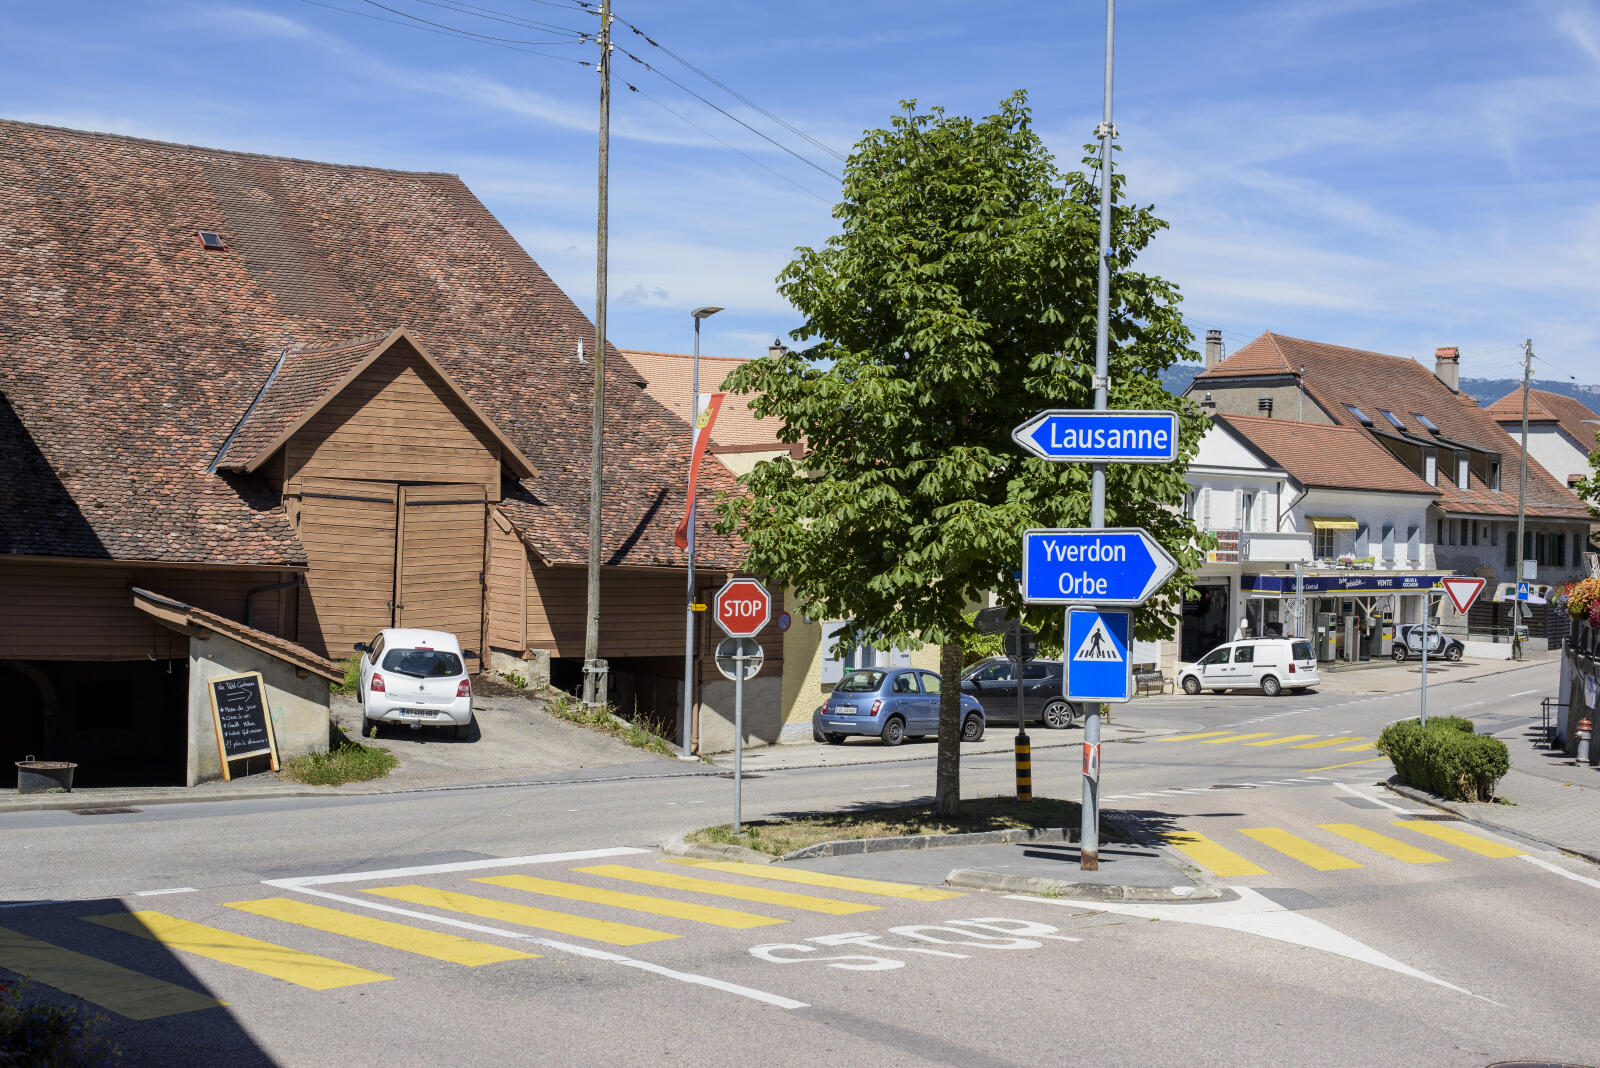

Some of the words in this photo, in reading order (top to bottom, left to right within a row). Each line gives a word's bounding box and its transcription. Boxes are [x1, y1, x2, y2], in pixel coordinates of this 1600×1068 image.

[1051, 422, 1168, 450] Lausanne
[1042, 538, 1126, 562] Yverdon
[1058, 570, 1108, 595] Orbe
[1376, 579, 1393, 587] VENTE
[724, 600, 762, 617] STOP
[748, 917, 1084, 971] STOP
